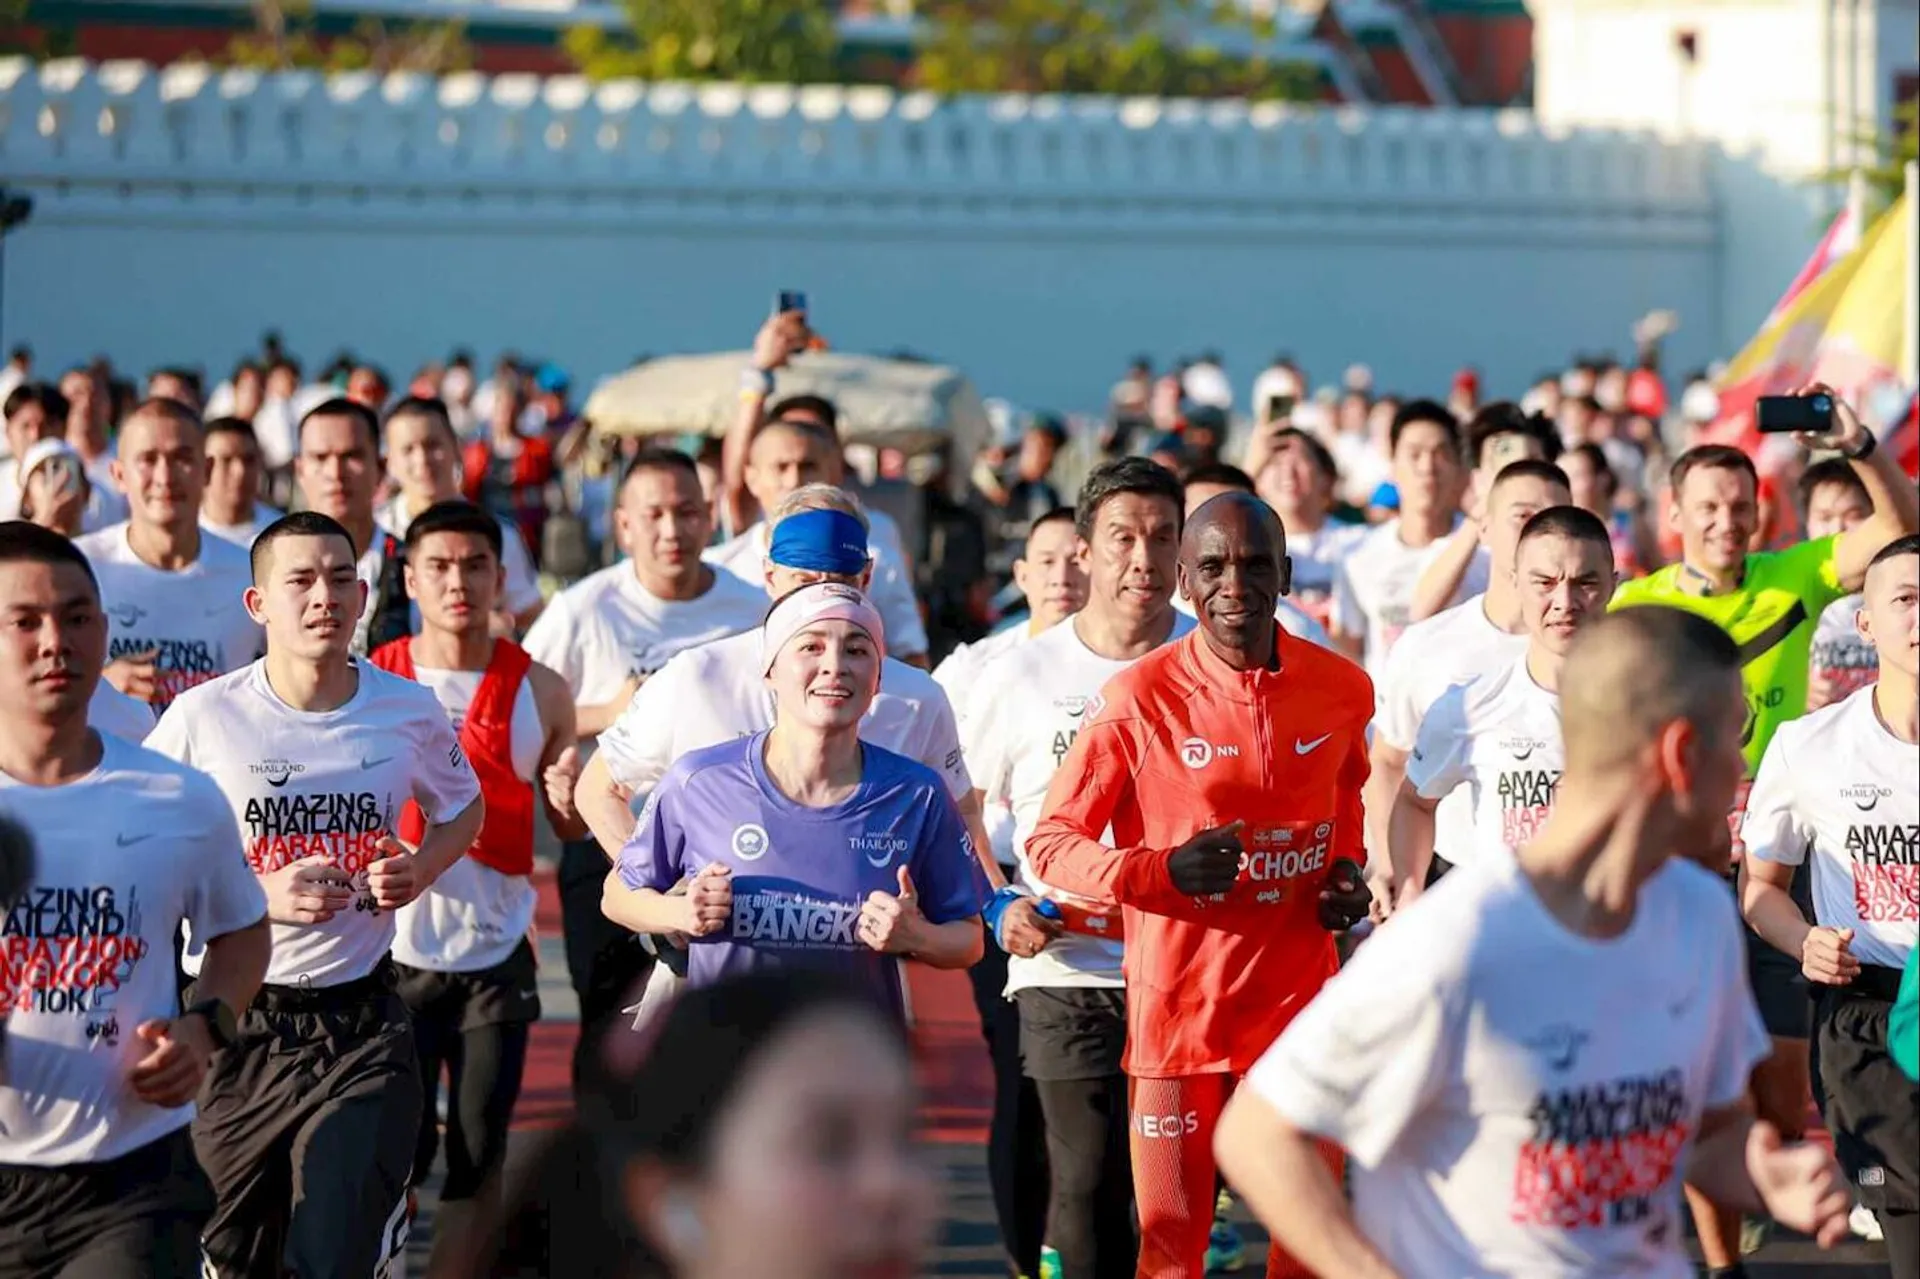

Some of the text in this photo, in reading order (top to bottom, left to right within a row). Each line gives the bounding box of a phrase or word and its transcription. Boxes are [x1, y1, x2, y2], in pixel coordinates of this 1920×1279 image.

[1216, 745, 1239, 757] NN
[1839, 787, 1892, 799] THAILAND
[246, 791, 377, 821] AMAZING
[246, 810, 383, 837] THAILAND
[849, 837, 908, 851] THAILAND
[1856, 899, 1919, 922] 2024
[733, 904, 864, 944] BANGK
[37, 986, 88, 1014] 10K
